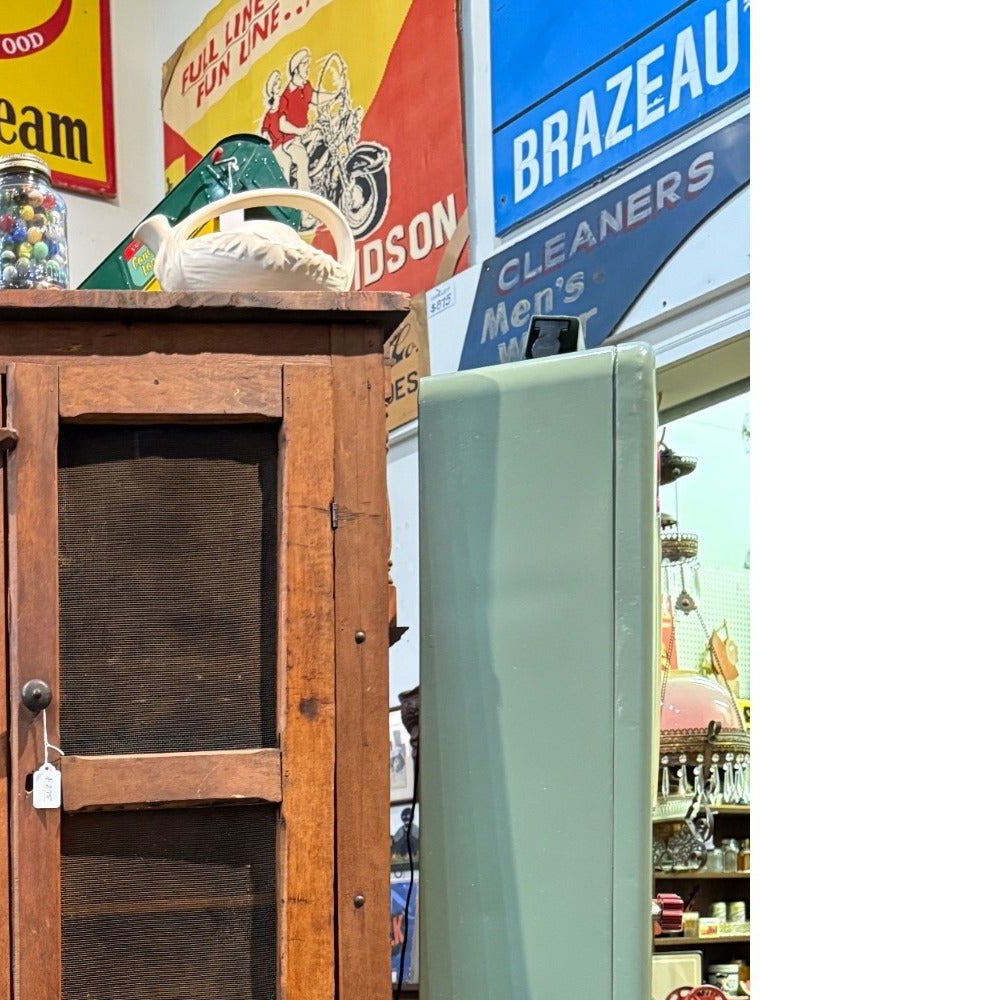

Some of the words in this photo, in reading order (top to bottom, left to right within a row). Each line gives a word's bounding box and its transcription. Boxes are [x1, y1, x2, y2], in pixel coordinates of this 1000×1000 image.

[181, 38, 218, 97] FULL
[225, 0, 264, 46] LINE
[196, 51, 231, 108] FUN
[513, 0, 750, 204] BRAZEAU
[498, 151, 714, 292] CLEANERS
[480, 272, 585, 344] Men's
